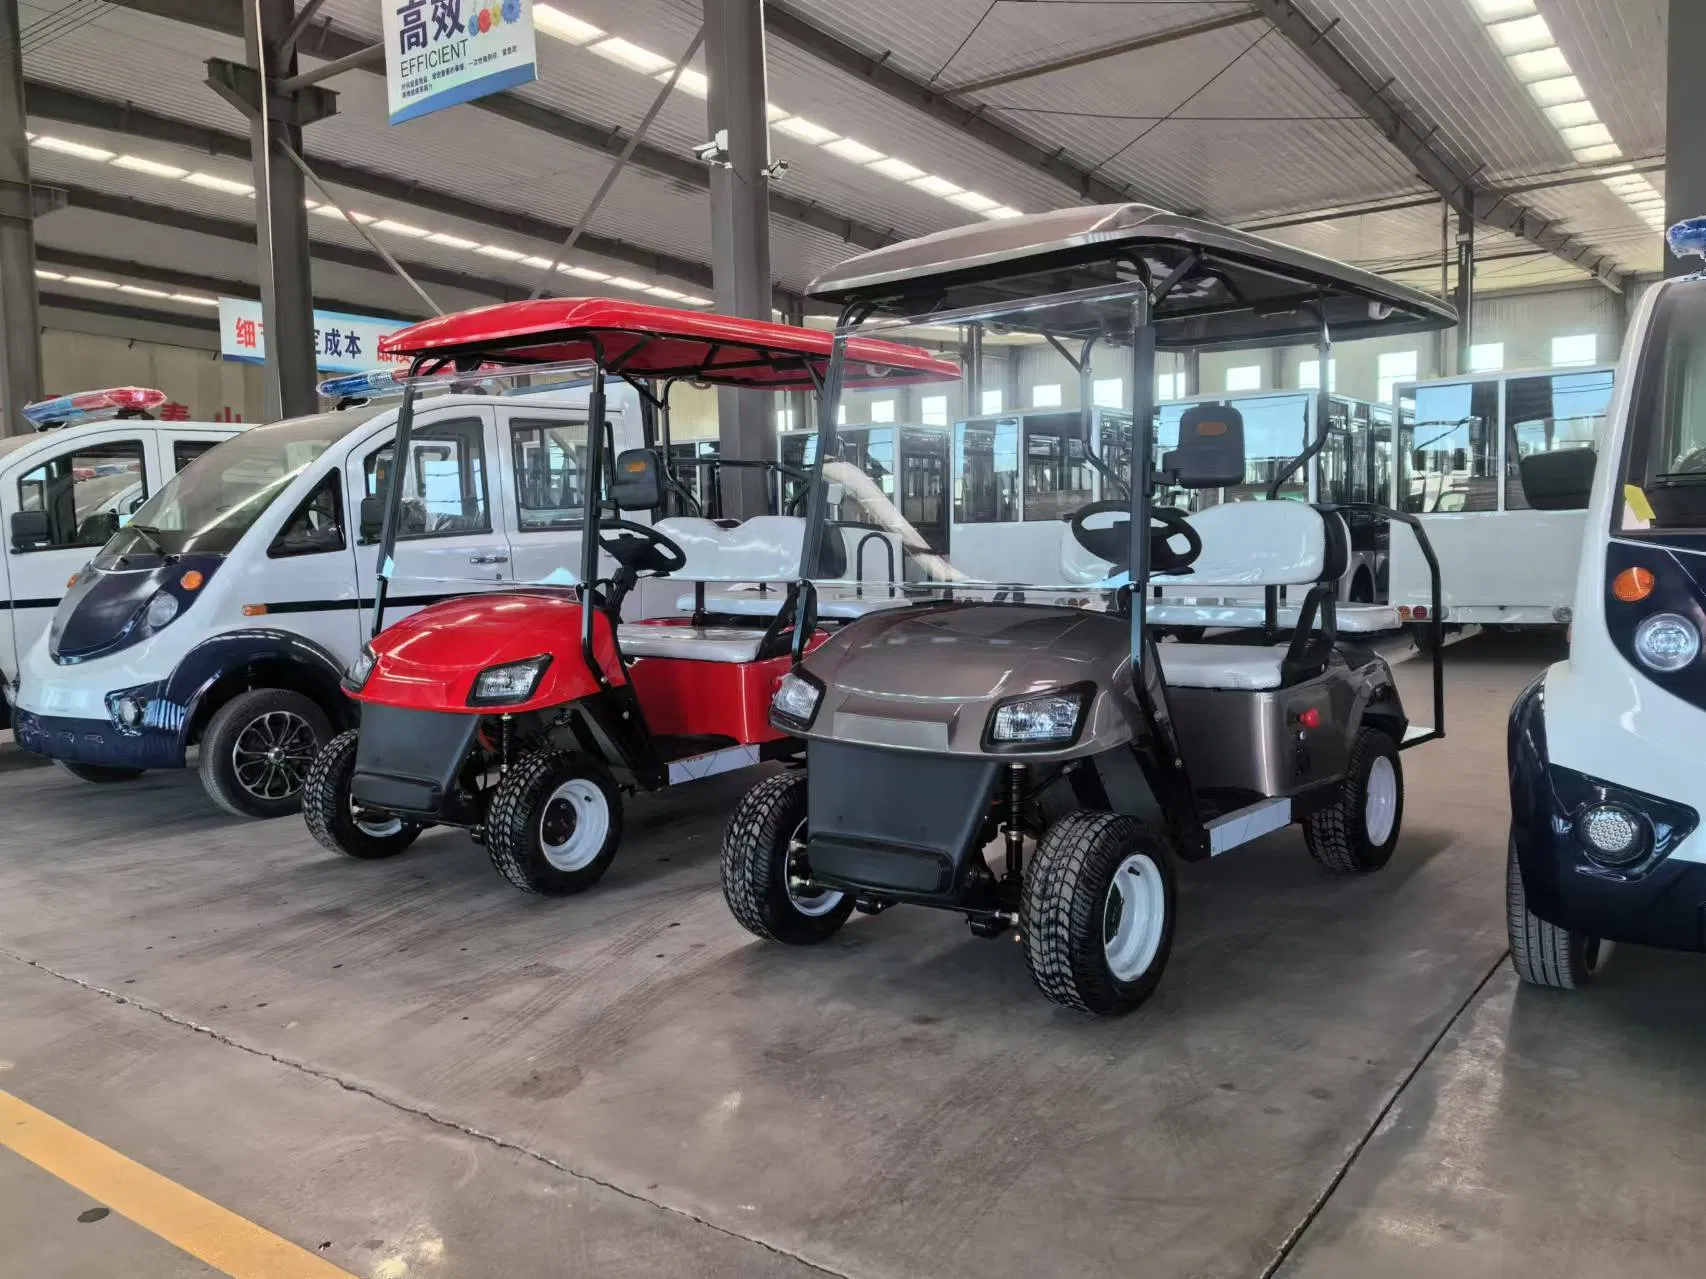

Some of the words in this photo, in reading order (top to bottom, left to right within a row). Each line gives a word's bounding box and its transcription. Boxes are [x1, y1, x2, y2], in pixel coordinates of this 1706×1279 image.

[396, 0, 465, 55] 高效
[400, 38, 468, 78] EFFICIENT
[236, 317, 264, 348] 细
